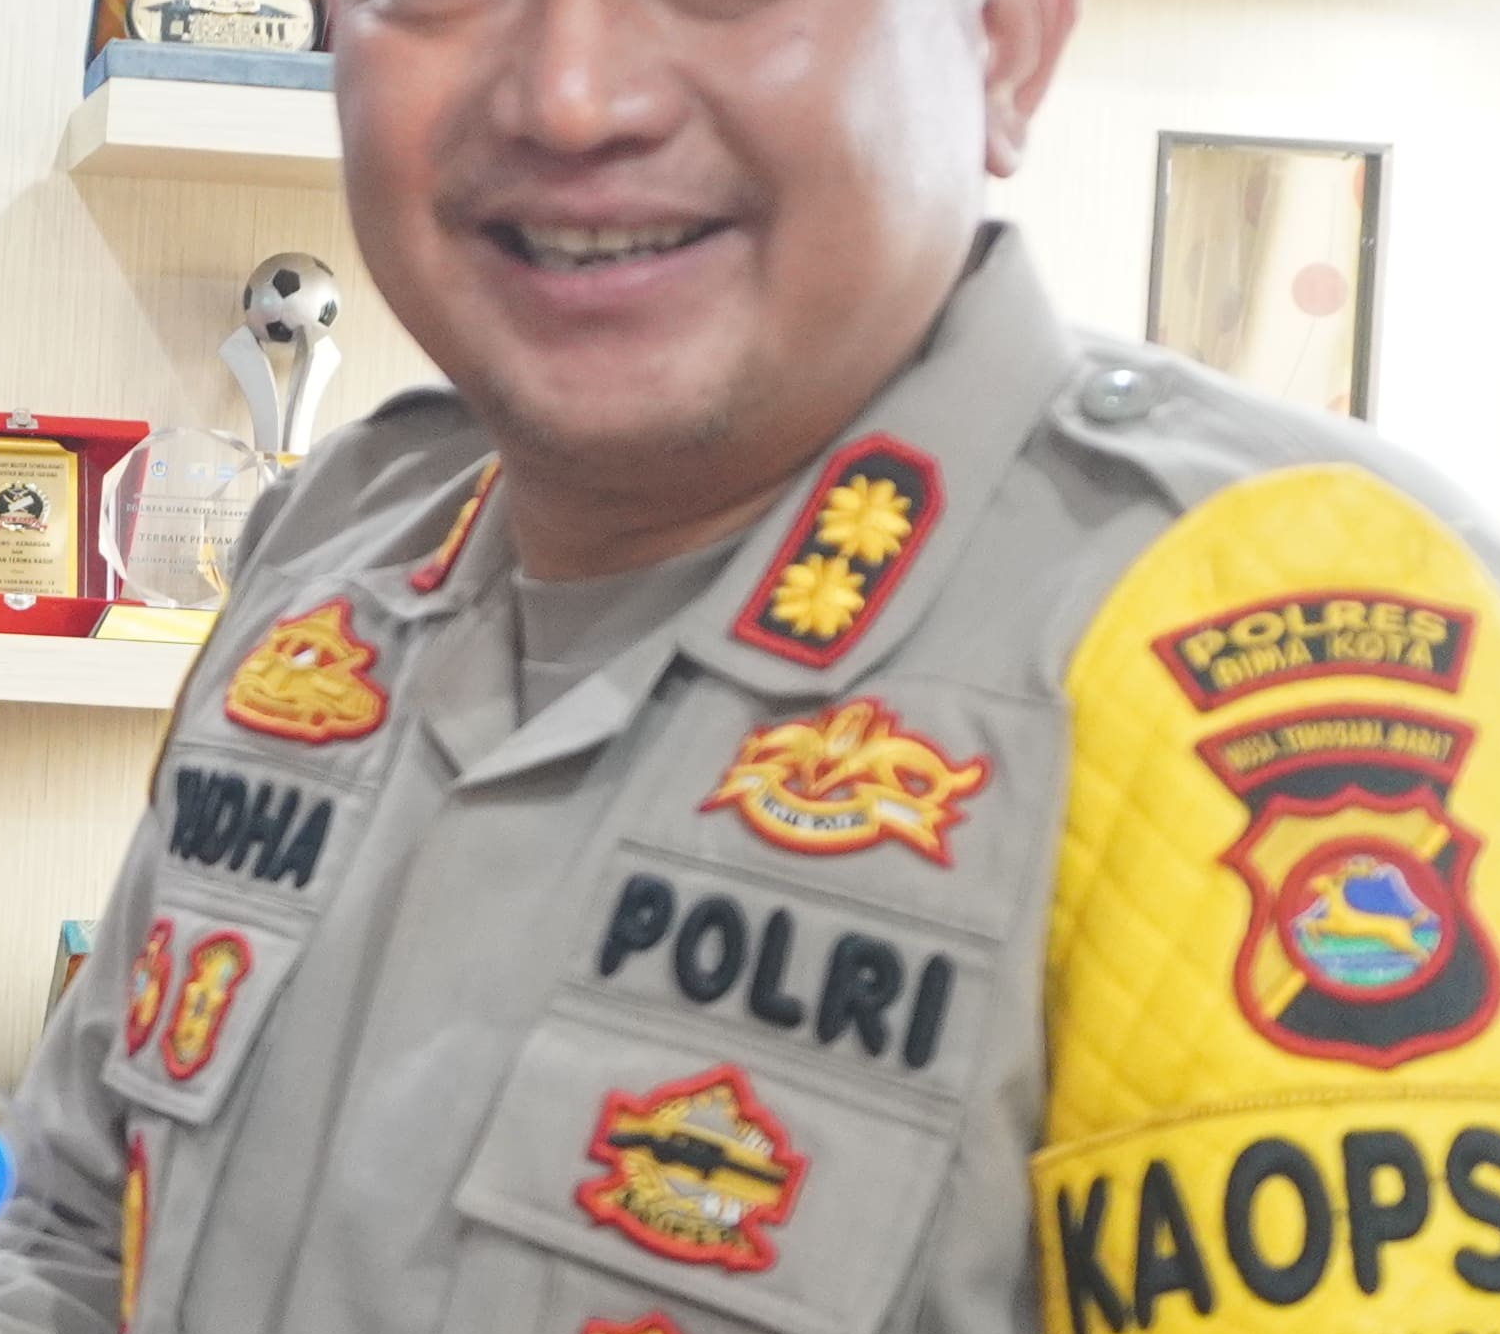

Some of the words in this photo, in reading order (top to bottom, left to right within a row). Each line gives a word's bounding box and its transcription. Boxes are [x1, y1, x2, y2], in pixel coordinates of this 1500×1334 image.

[1182, 600, 1448, 671] POLRES
[1327, 631, 1434, 669] KOTA
[599, 870, 954, 1069] POLRI
